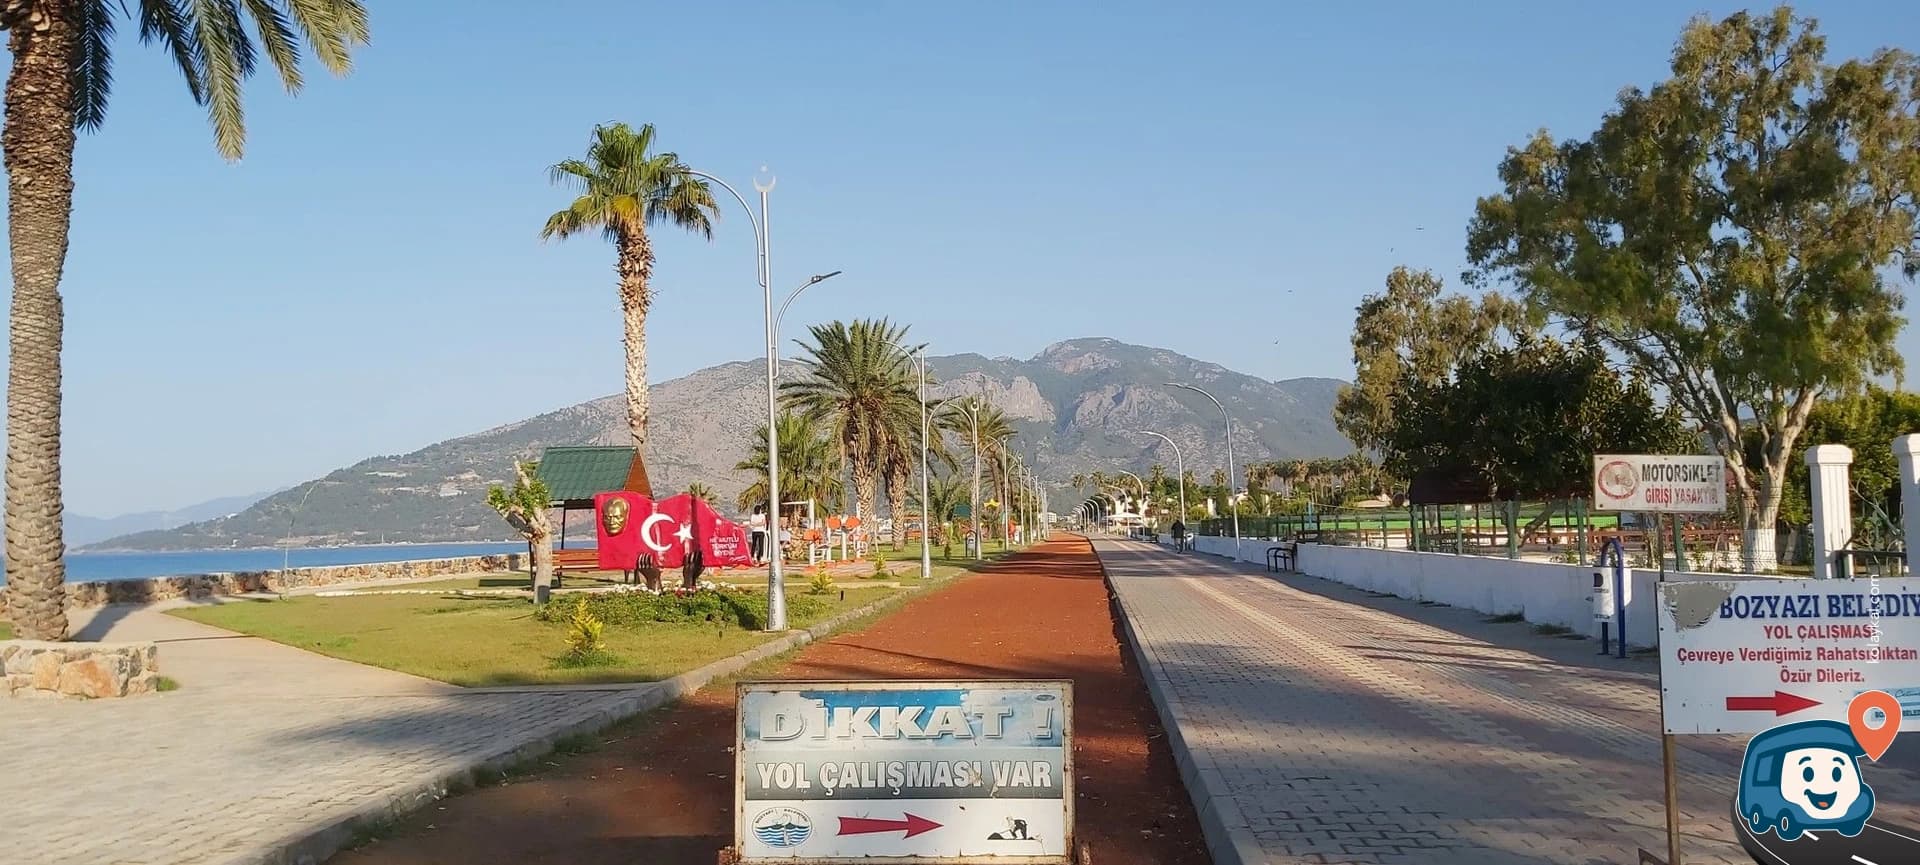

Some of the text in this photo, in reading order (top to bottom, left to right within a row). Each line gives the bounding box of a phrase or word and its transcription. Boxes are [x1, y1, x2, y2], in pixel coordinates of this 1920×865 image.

[1645, 484, 1672, 507] GİRİŞİ
[1719, 594, 1820, 618] BOZYAZI
[1763, 625, 1793, 639] YOL
[1677, 647, 1734, 665] Çevreye
[1739, 646, 1812, 664] Verdiğimiz
[1780, 665, 1865, 683] Özür Dileriz.
[760, 699, 1013, 741] DİKKAT
[756, 761, 1052, 796] YOL ÇALIŞMASI VAR
